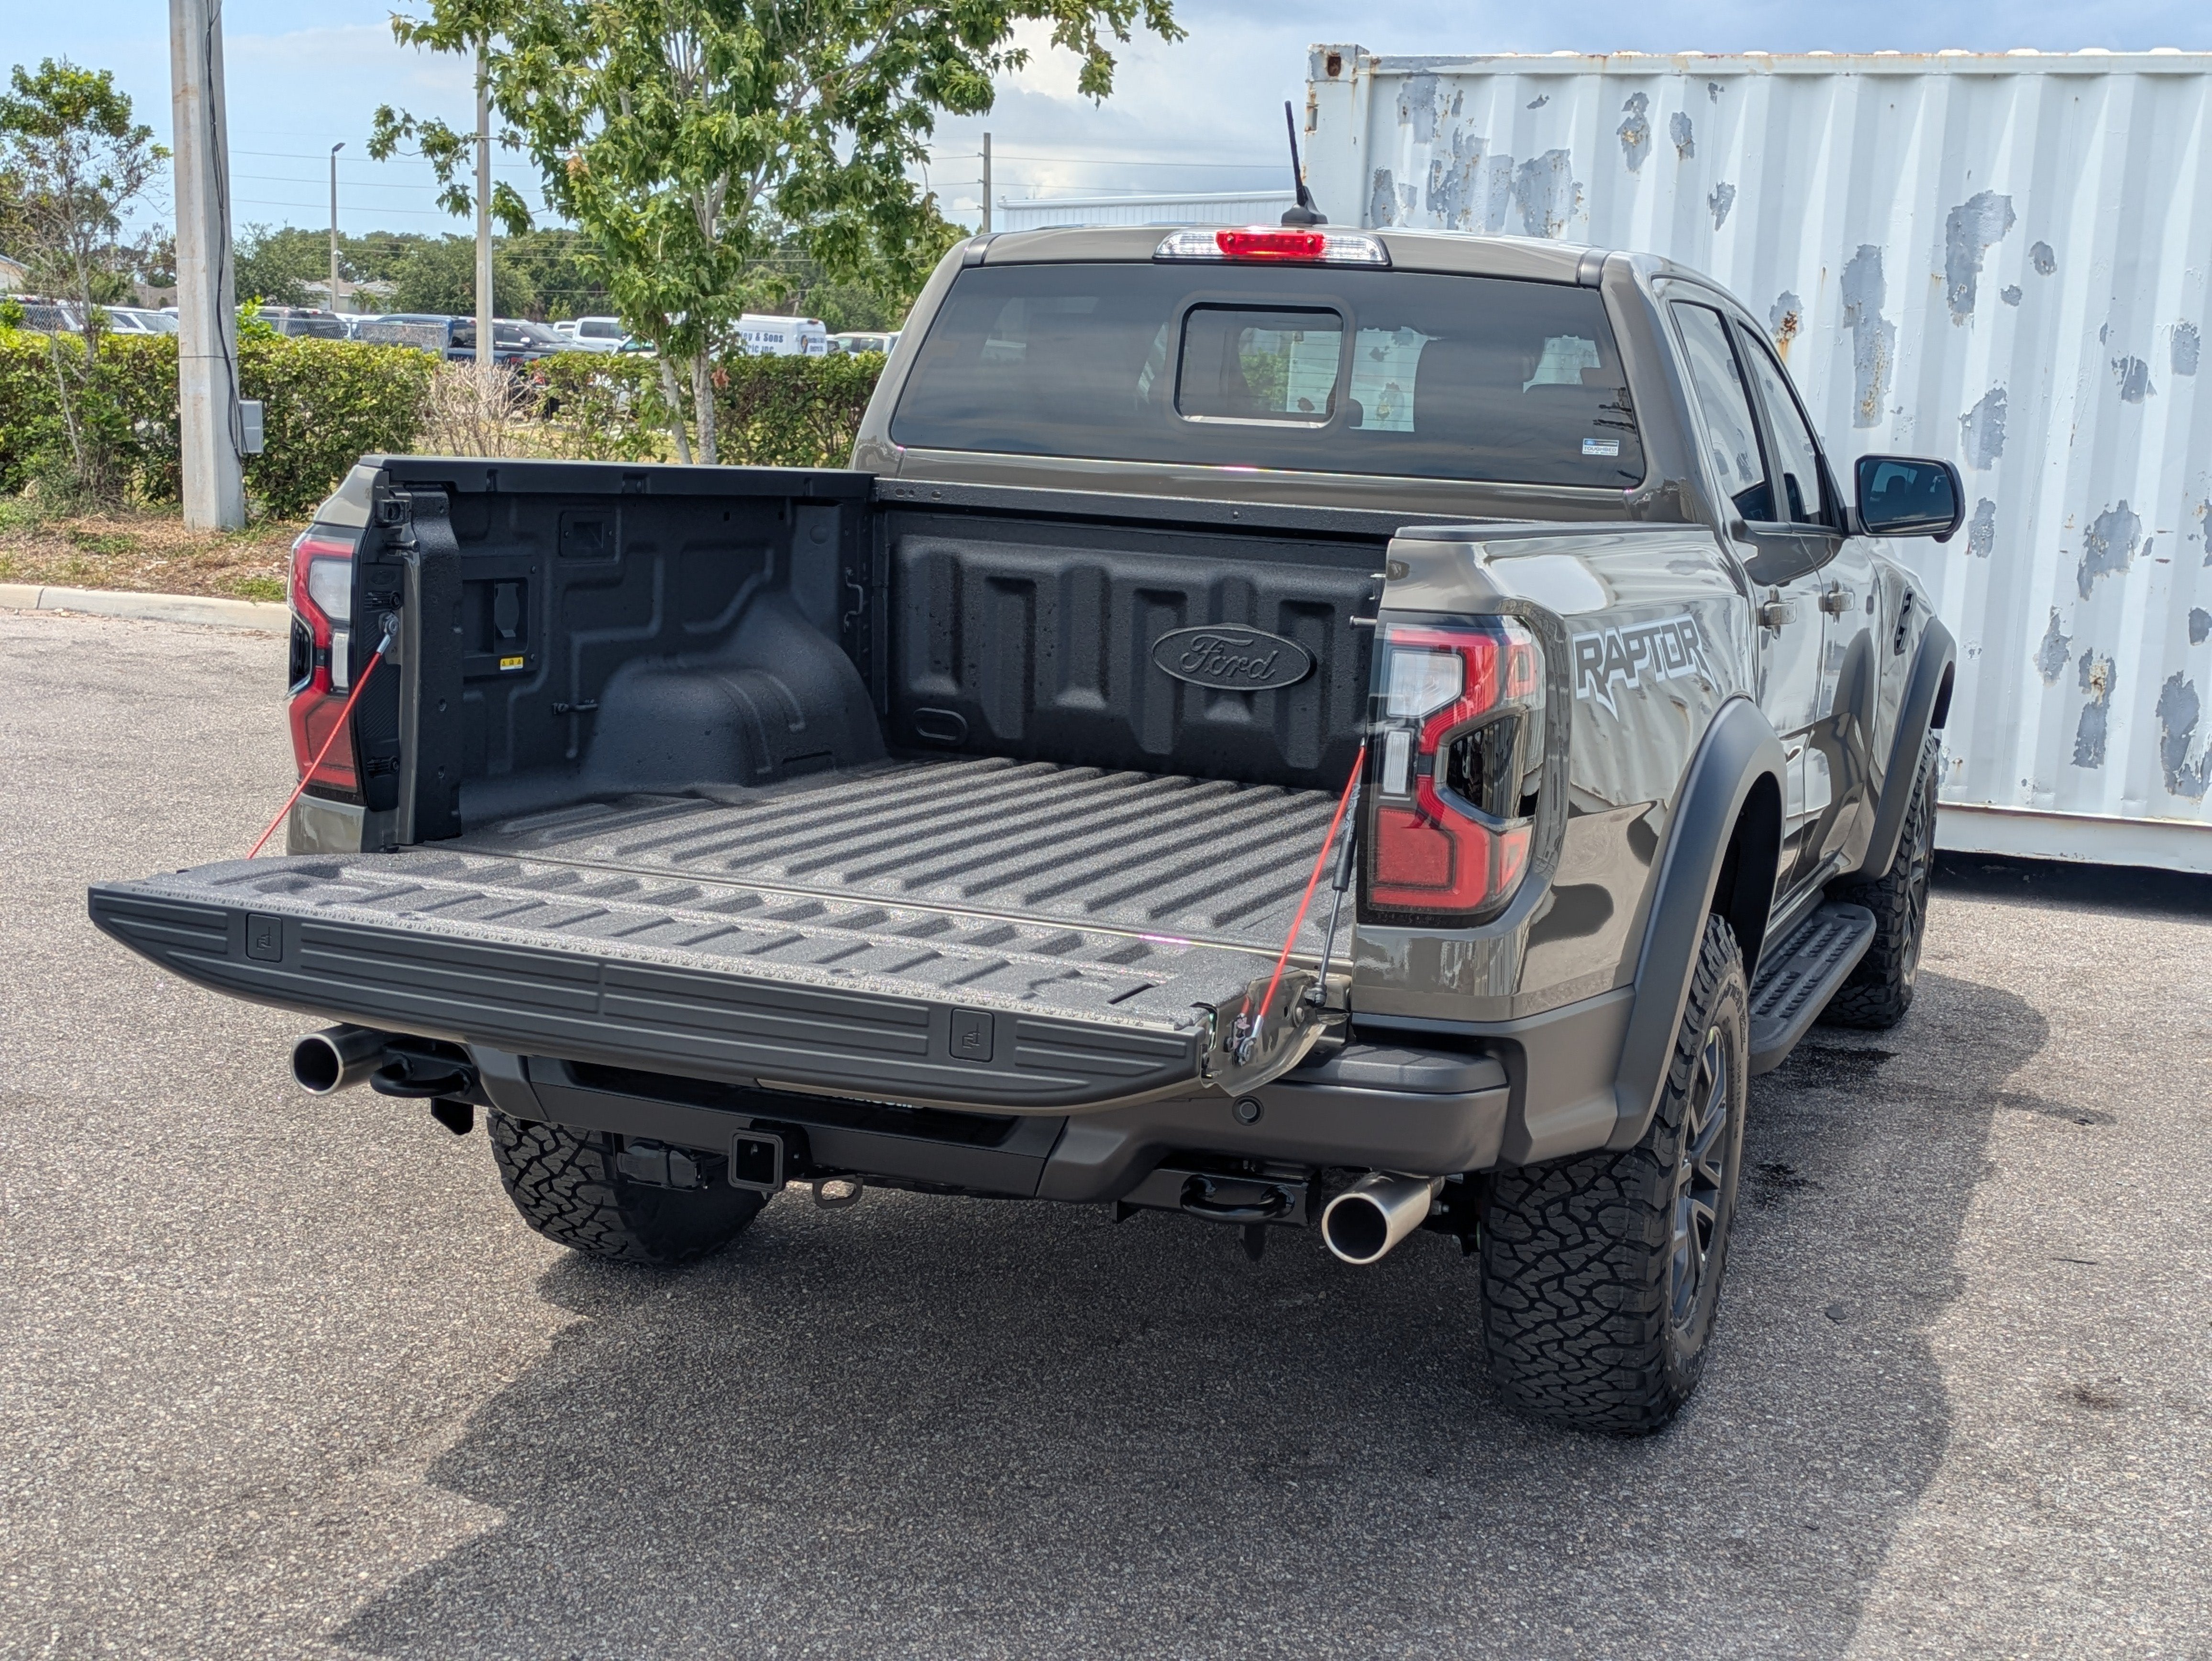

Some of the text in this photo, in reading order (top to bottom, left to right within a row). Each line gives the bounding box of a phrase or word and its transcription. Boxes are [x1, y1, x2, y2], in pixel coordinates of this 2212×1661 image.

[755, 332, 760, 342] &
[763, 332, 784, 343] Sons
[1179, 633, 1279, 680] Ford
[1572, 614, 1719, 722] RAPTOR
